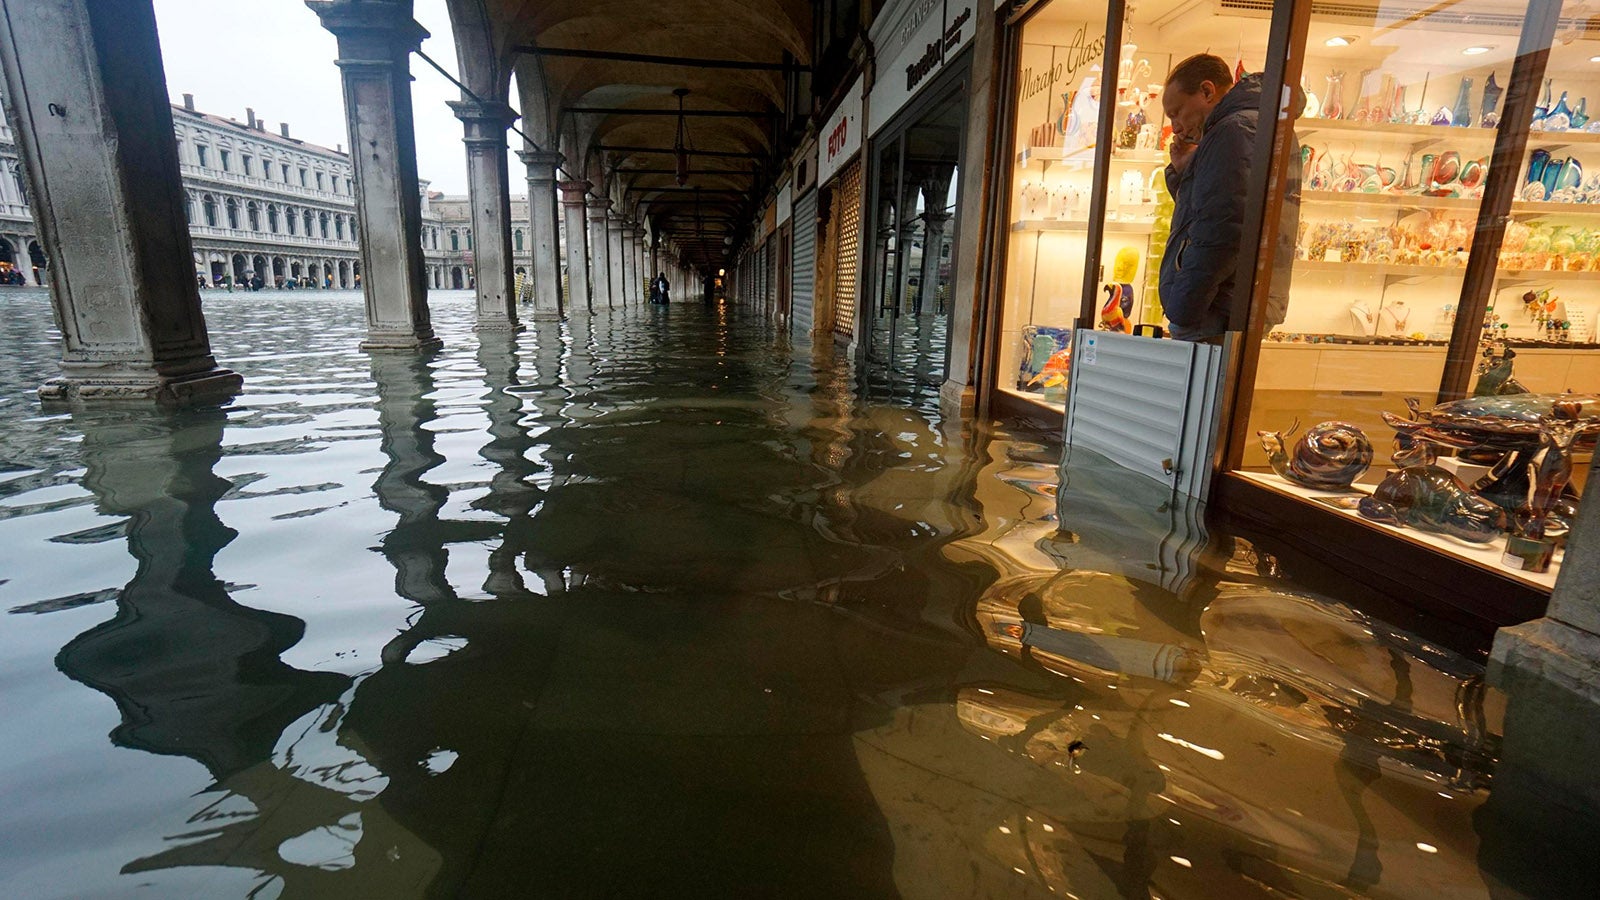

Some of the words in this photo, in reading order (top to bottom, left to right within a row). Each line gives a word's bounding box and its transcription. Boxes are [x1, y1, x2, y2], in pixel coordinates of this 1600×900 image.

[1019, 63, 1063, 103] Murano
[1065, 21, 1105, 86] Glass
[827, 116, 847, 163] FOTO
